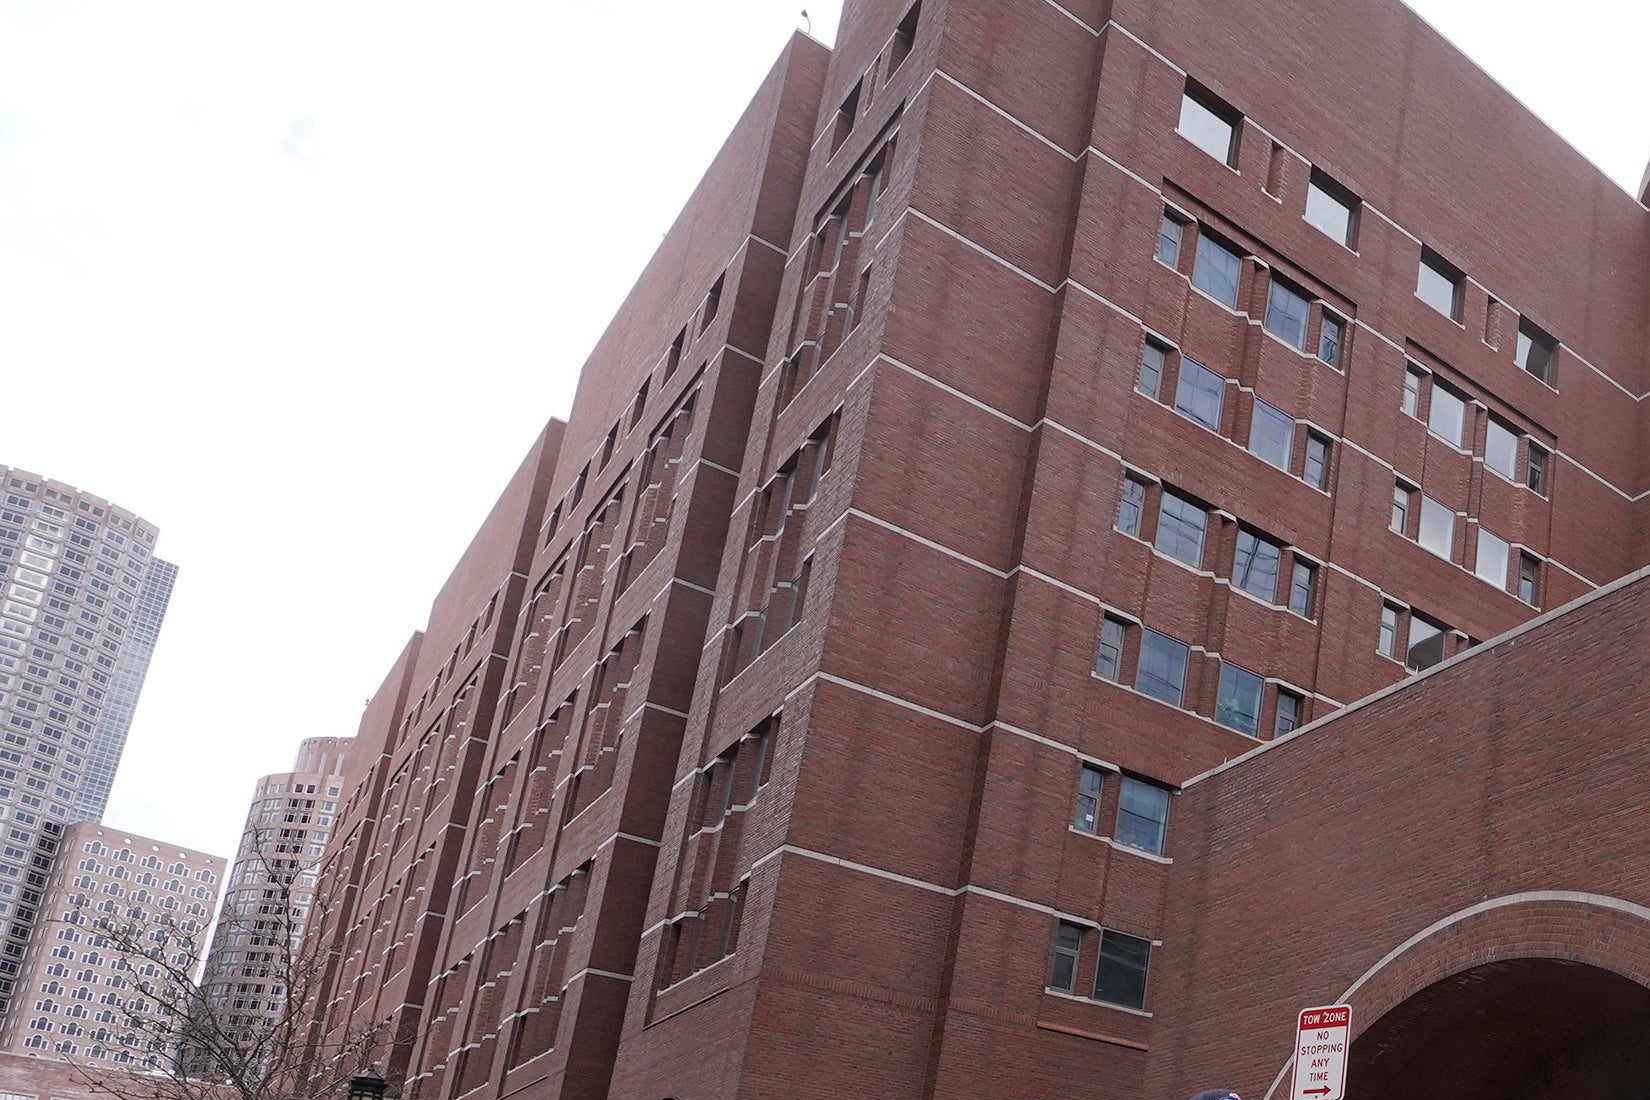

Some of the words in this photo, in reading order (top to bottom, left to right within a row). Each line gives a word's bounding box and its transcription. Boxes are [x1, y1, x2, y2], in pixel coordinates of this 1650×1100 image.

[1303, 1014, 1321, 1025] TOW
[1323, 1011, 1347, 1023] ZONE
[1316, 1030, 1330, 1041] NO
[1300, 1043, 1343, 1056] STOPPING
[1310, 1058, 1330, 1068] ANY
[1309, 1071, 1329, 1082] TIME
